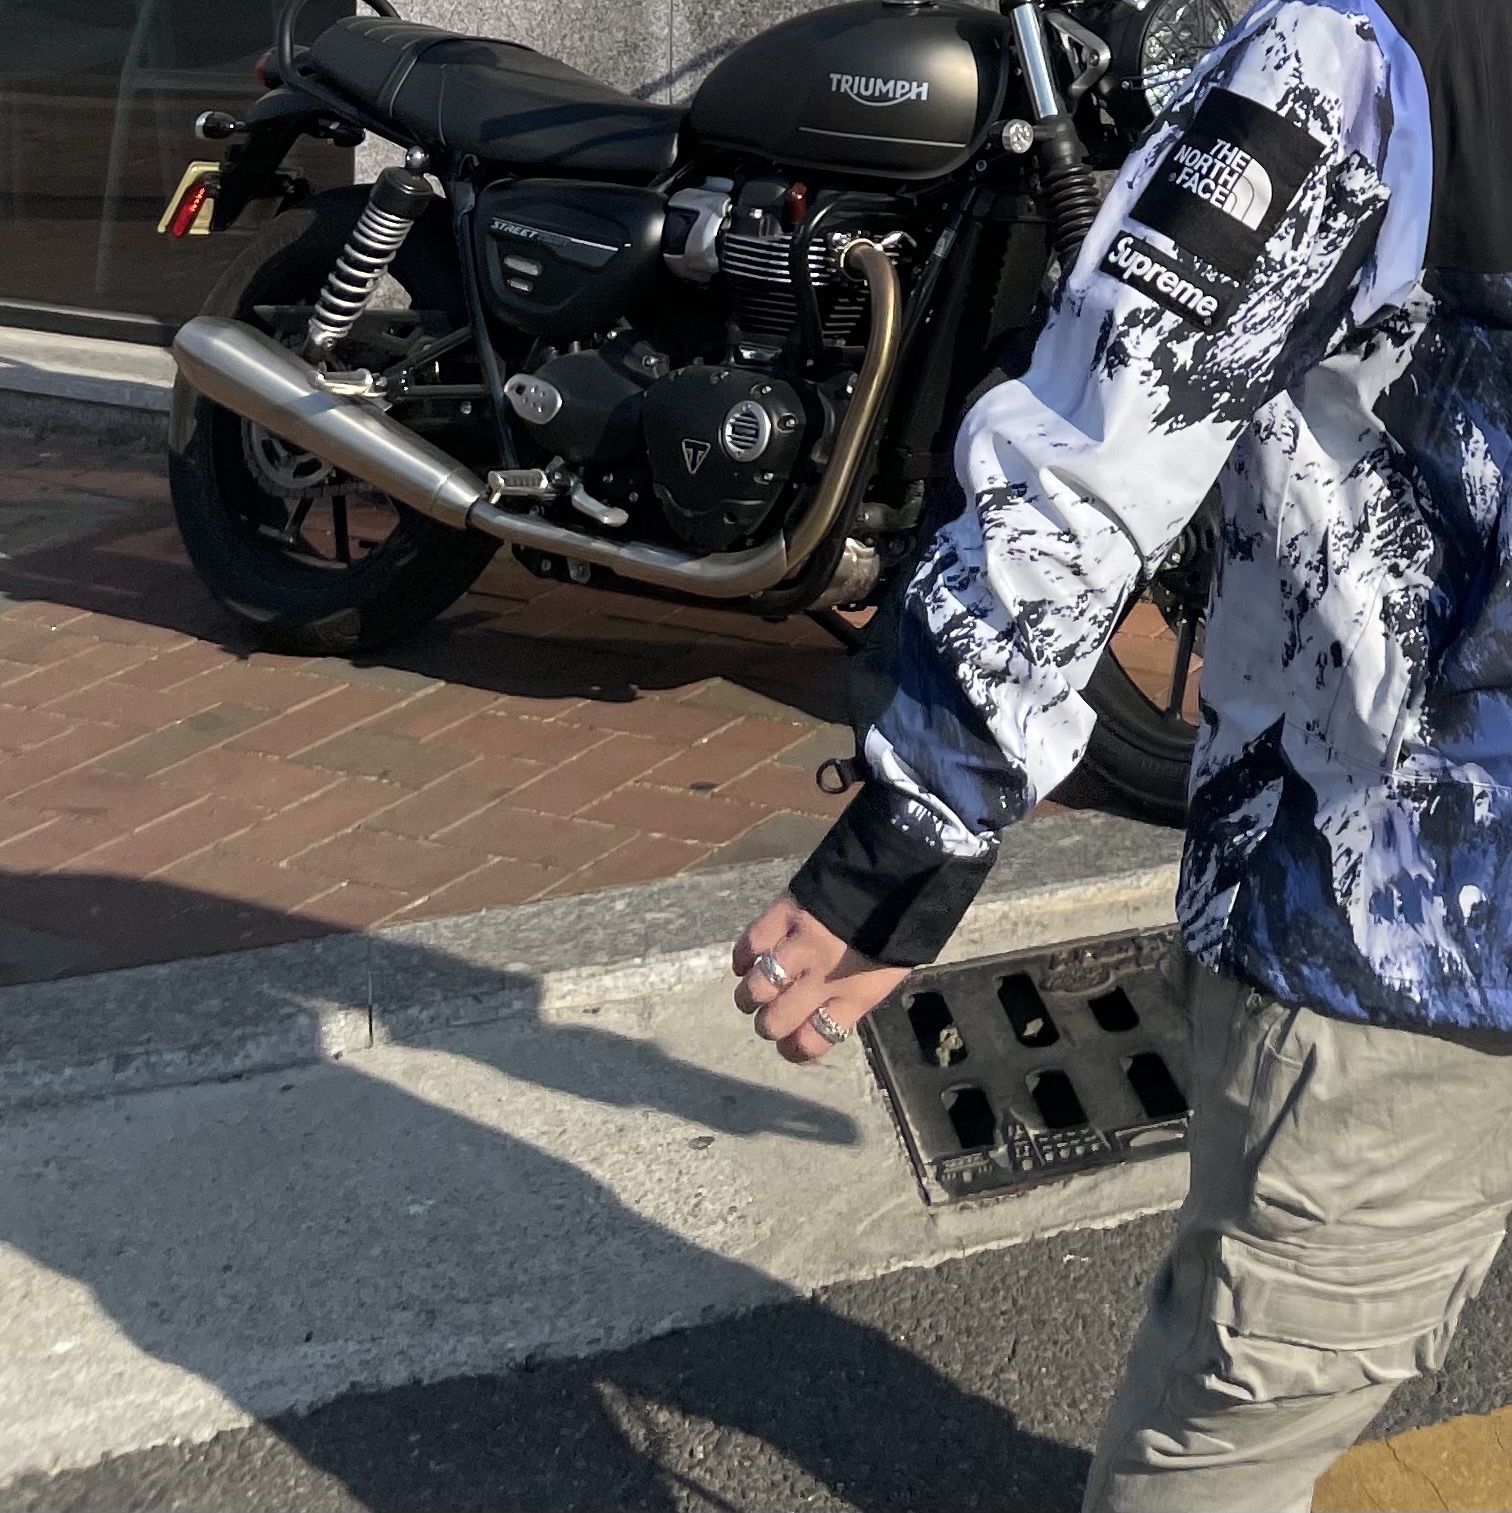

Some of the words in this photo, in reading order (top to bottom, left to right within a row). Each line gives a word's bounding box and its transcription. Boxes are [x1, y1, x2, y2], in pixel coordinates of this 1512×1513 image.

[829, 72, 929, 105] TRIUMPH
[1173, 144, 1240, 190] NORTH
[1209, 139, 1251, 169] THE
[1175, 167, 1230, 208] FACE
[490, 219, 539, 239] STREET
[1108, 236, 1219, 317] Supreme
